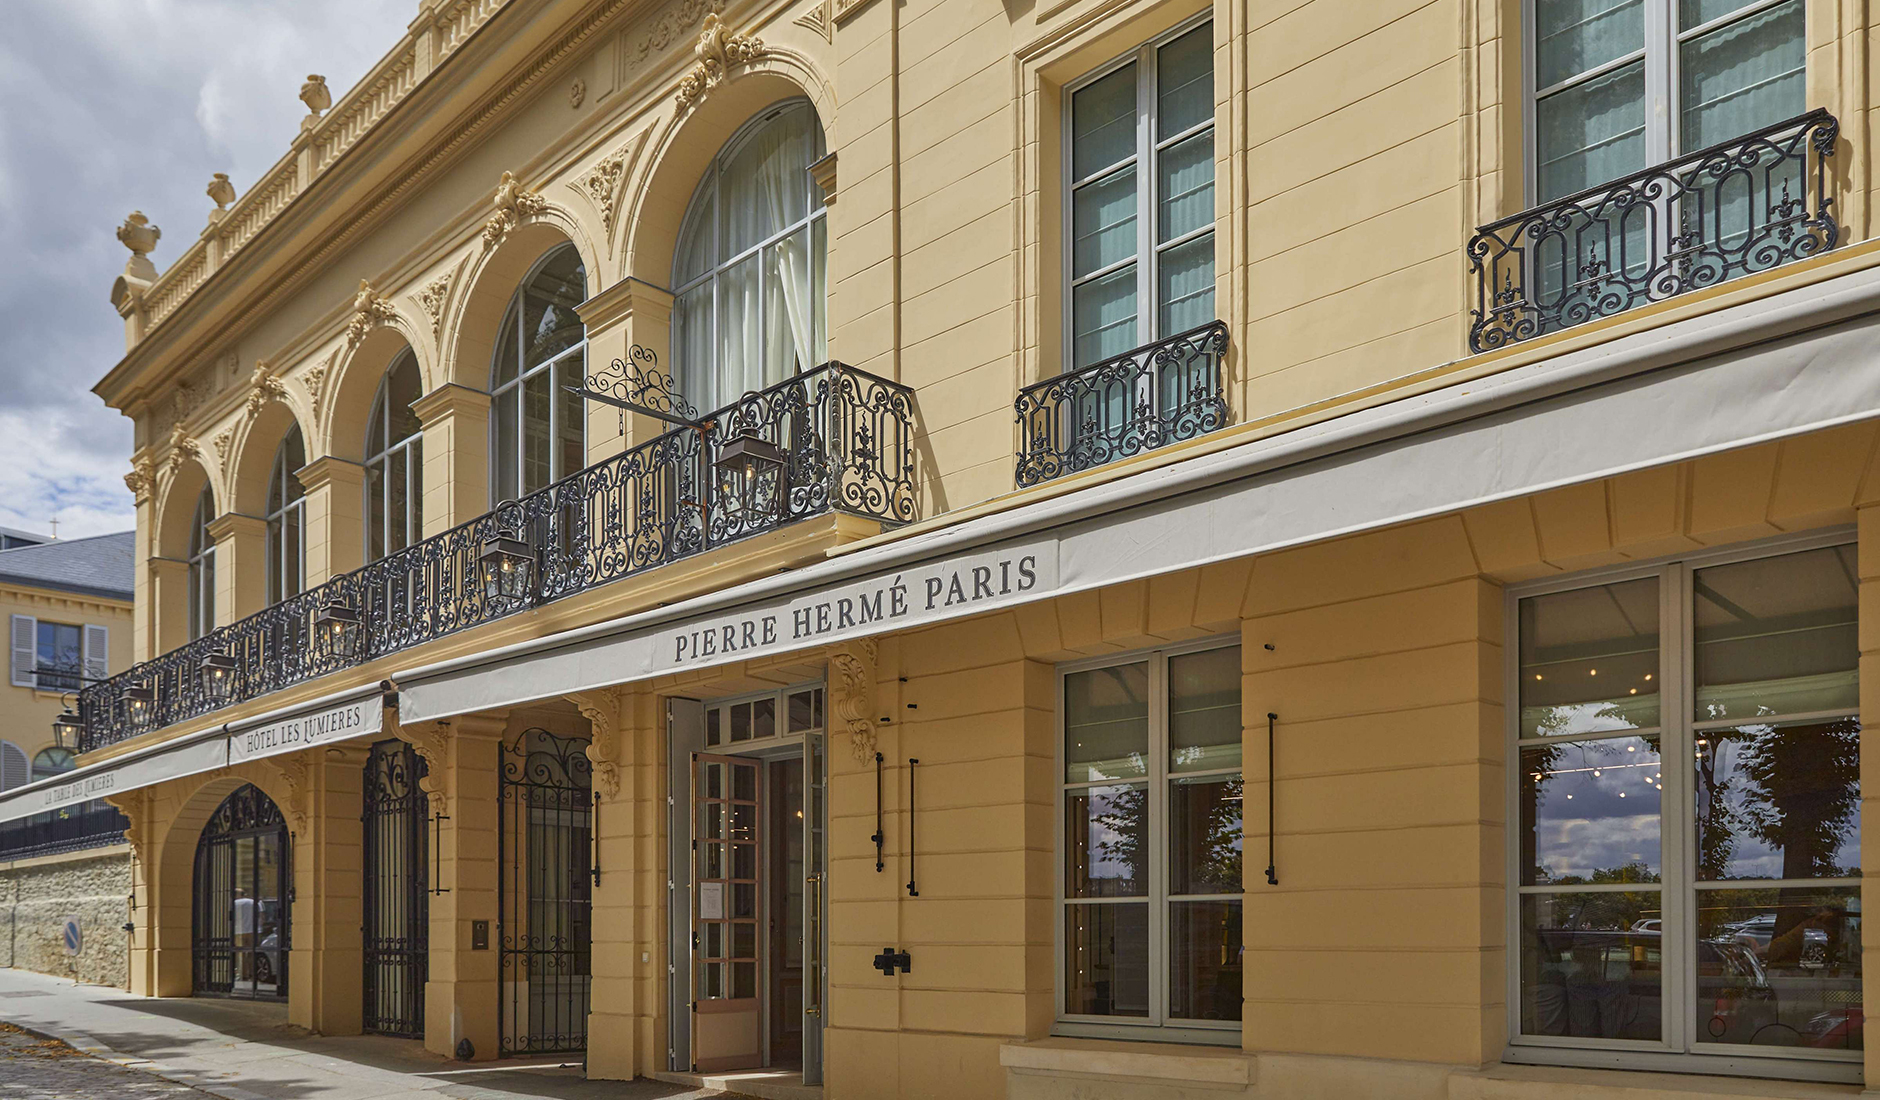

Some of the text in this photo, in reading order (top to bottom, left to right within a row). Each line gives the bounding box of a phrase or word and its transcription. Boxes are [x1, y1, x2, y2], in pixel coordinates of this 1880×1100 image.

[675, 555, 1036, 662] PIERRE HERMÉ PARIS
[246, 729, 278, 752] HÔTEL
[281, 723, 300, 744] LES
